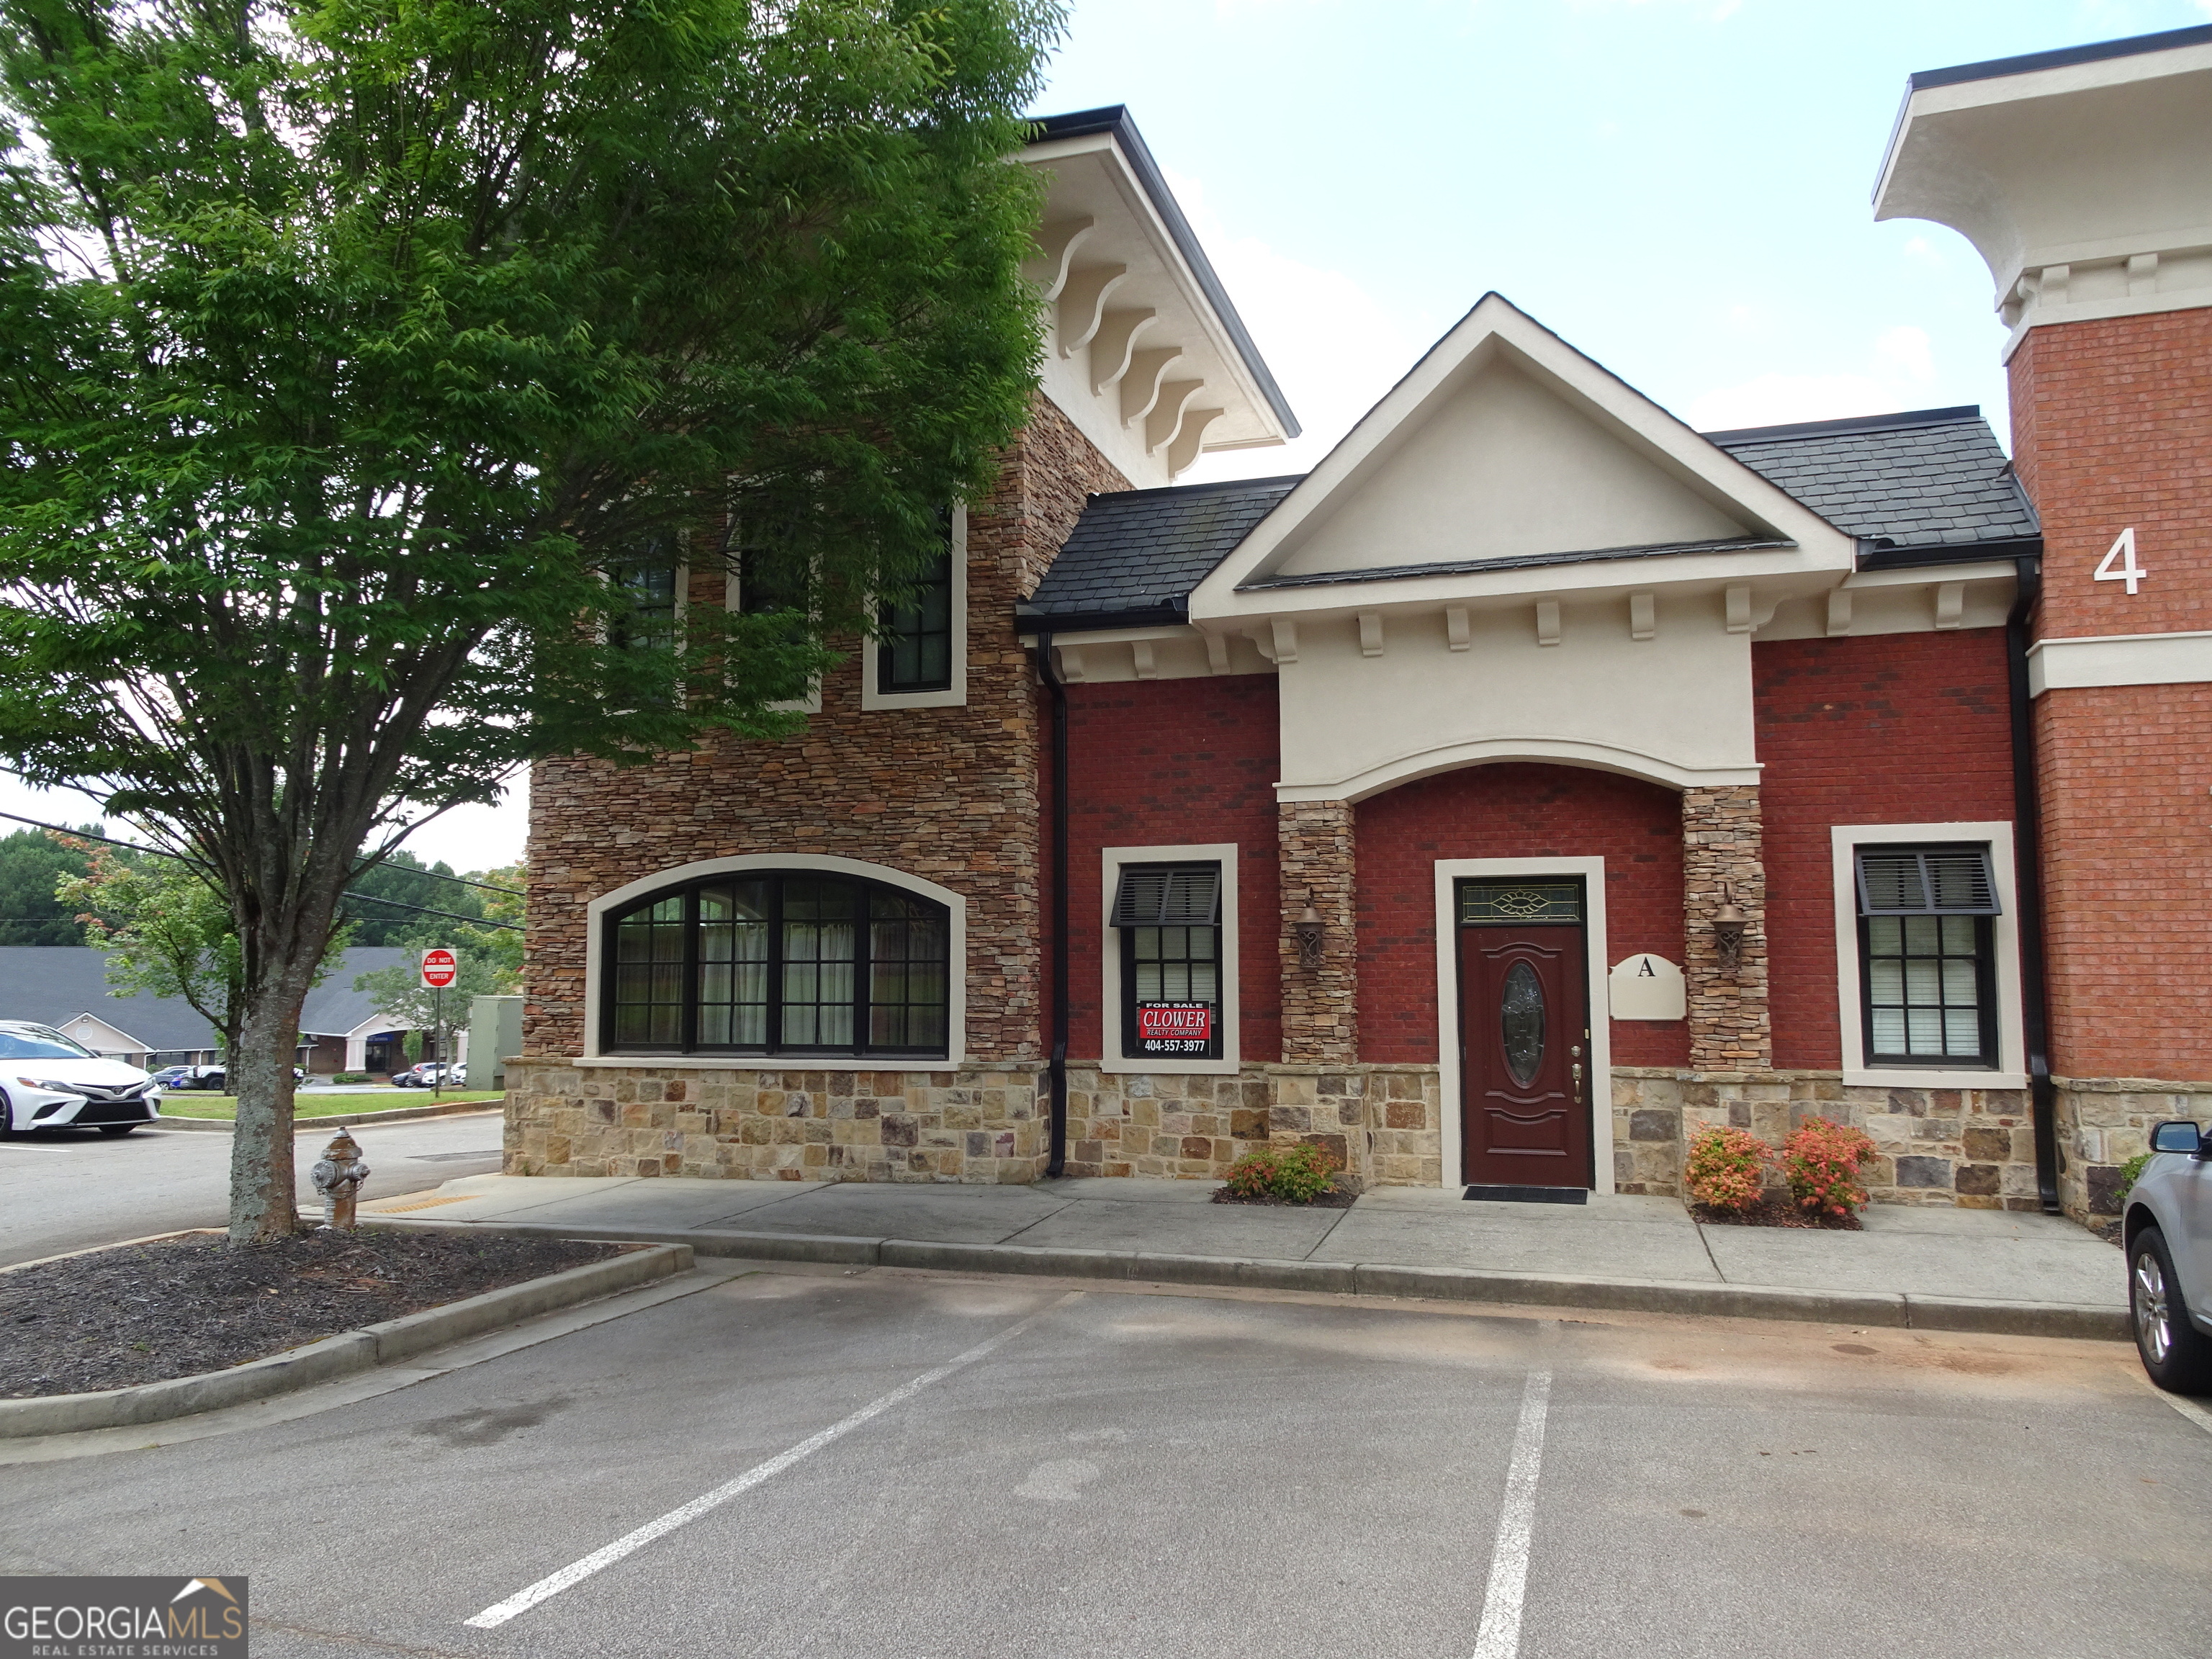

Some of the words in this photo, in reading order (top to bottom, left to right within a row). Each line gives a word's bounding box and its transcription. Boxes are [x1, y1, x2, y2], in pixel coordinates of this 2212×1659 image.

[2093, 527, 2147, 595] 4
[1637, 956, 1656, 976] A
[1143, 1011, 1205, 1027] CLOWER
[1145, 1040, 1205, 1051] 404-557-3977
